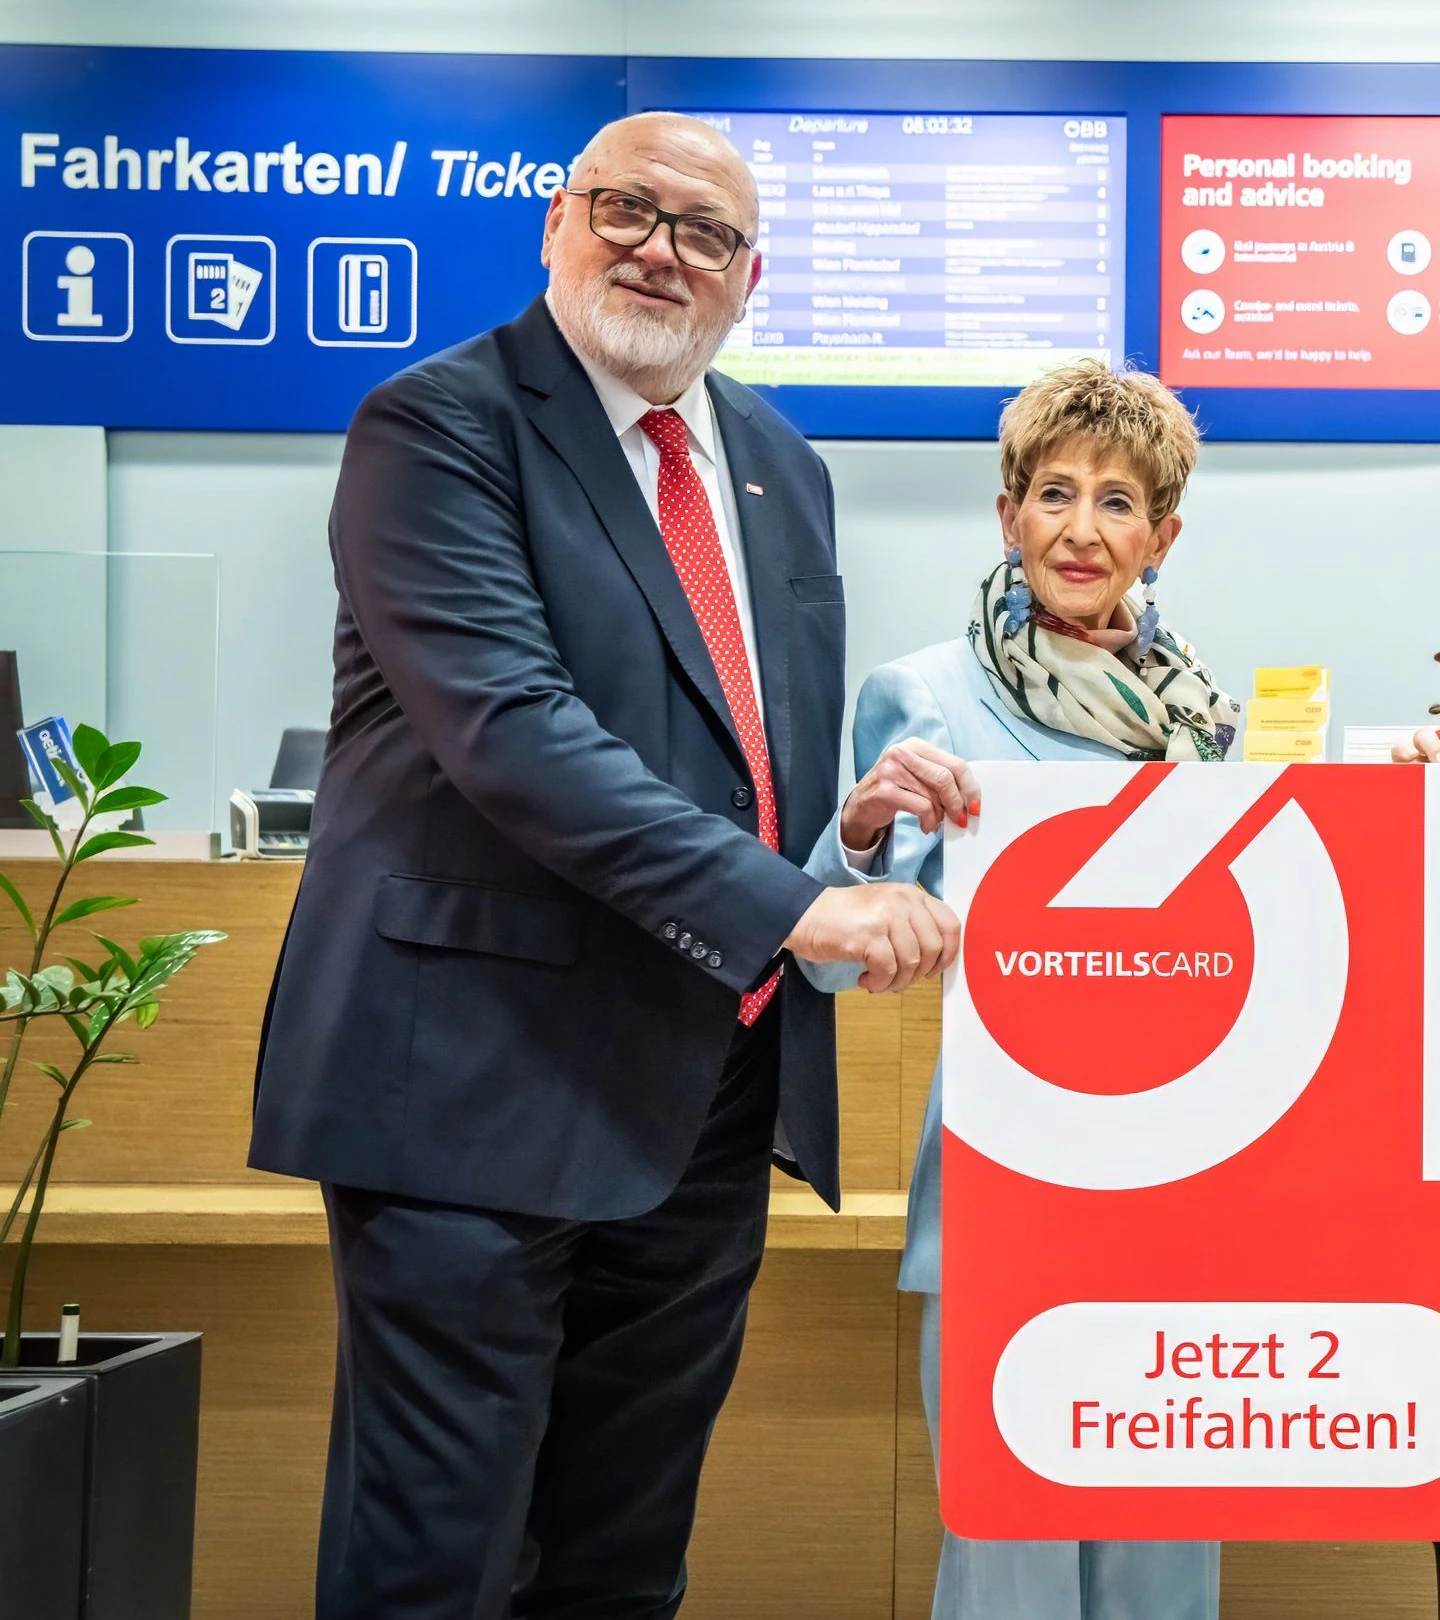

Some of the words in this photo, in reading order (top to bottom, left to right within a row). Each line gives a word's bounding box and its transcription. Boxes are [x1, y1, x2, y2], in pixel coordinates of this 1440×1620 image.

[21, 132, 408, 197] Fahrkarten/
[1183, 153, 1296, 178] Personal
[1303, 153, 1412, 184] booking
[1182, 181, 1233, 207] and
[1240, 181, 1325, 207] advice
[995, 950, 1234, 978] VORTEILSCARD
[1144, 1330, 1285, 1380] Jetzt
[1307, 1330, 1340, 1379] 2
[1071, 1396, 1417, 1451] Freifahrten!
